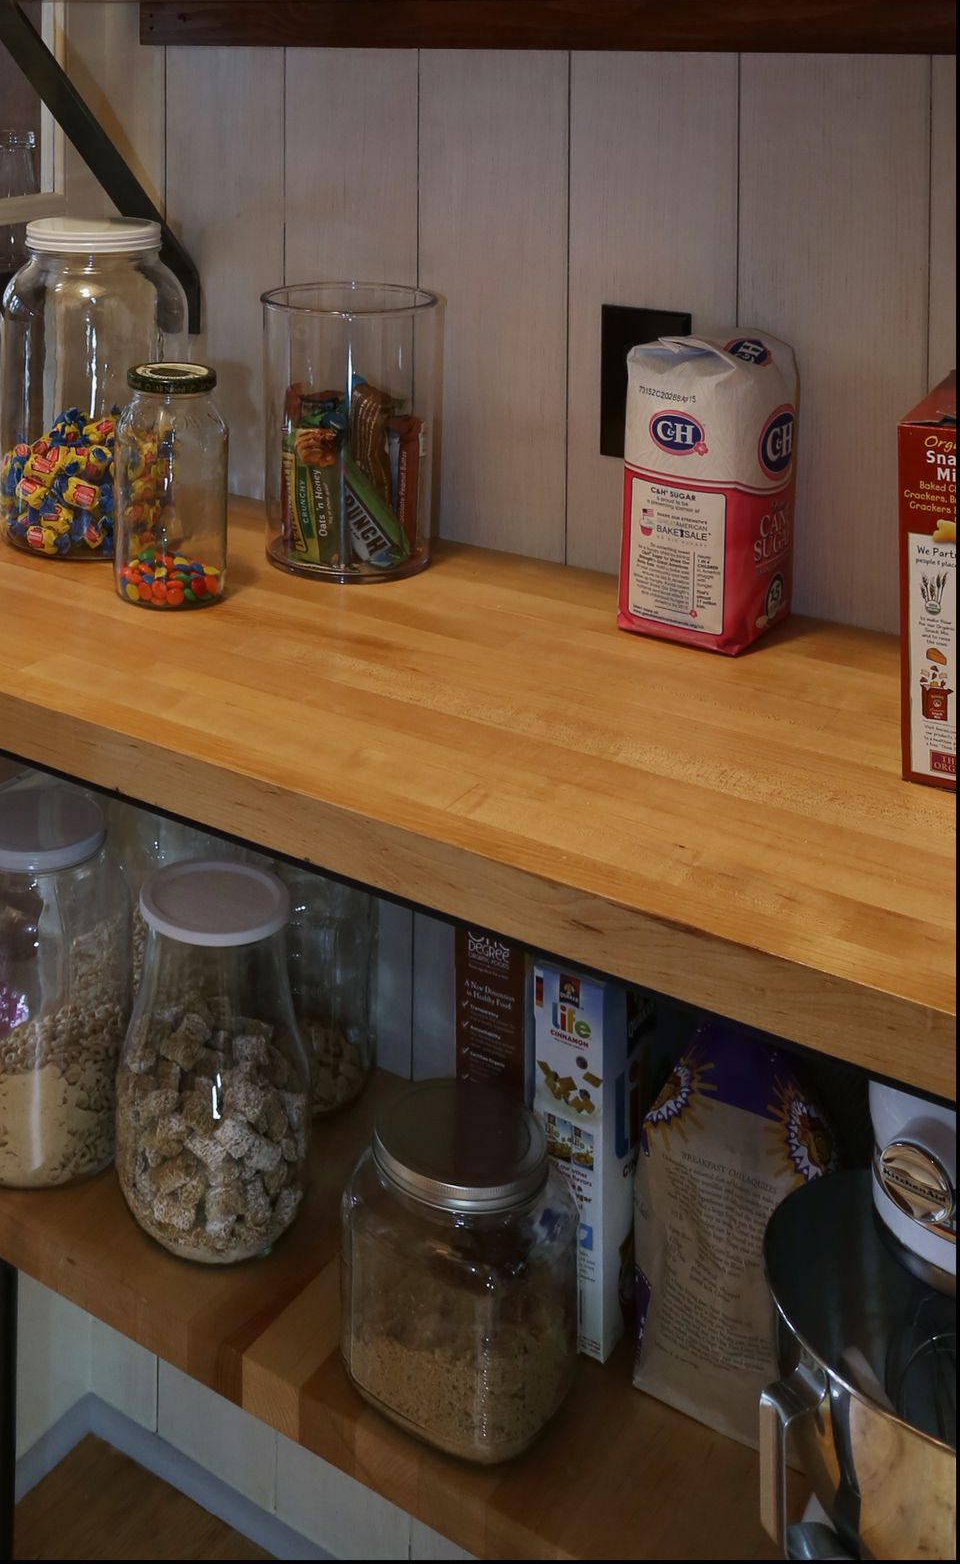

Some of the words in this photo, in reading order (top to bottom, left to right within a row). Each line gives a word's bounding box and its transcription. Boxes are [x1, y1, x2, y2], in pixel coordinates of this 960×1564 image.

[655, 419, 696, 446] C&H
[926, 450, 957, 466] Sna
[312, 469, 322, 499] Honey
[920, 480, 946, 493] Baked
[937, 467, 957, 483] Mi
[299, 479, 309, 524] CRUNCHY
[670, 491, 697, 502] SUGAR
[909, 500, 951, 514] Crackers
[318, 514, 328, 538] Oats
[760, 509, 788, 538] CAN
[754, 532, 789, 562] SUGA
[917, 545, 930, 556] We
[932, 547, 957, 559] Part
[916, 557, 936, 567] people
[551, 1002, 593, 1040] life
[550, 1028, 590, 1050] CINNAMON
[882, 1167, 947, 1203] KitchenAid
